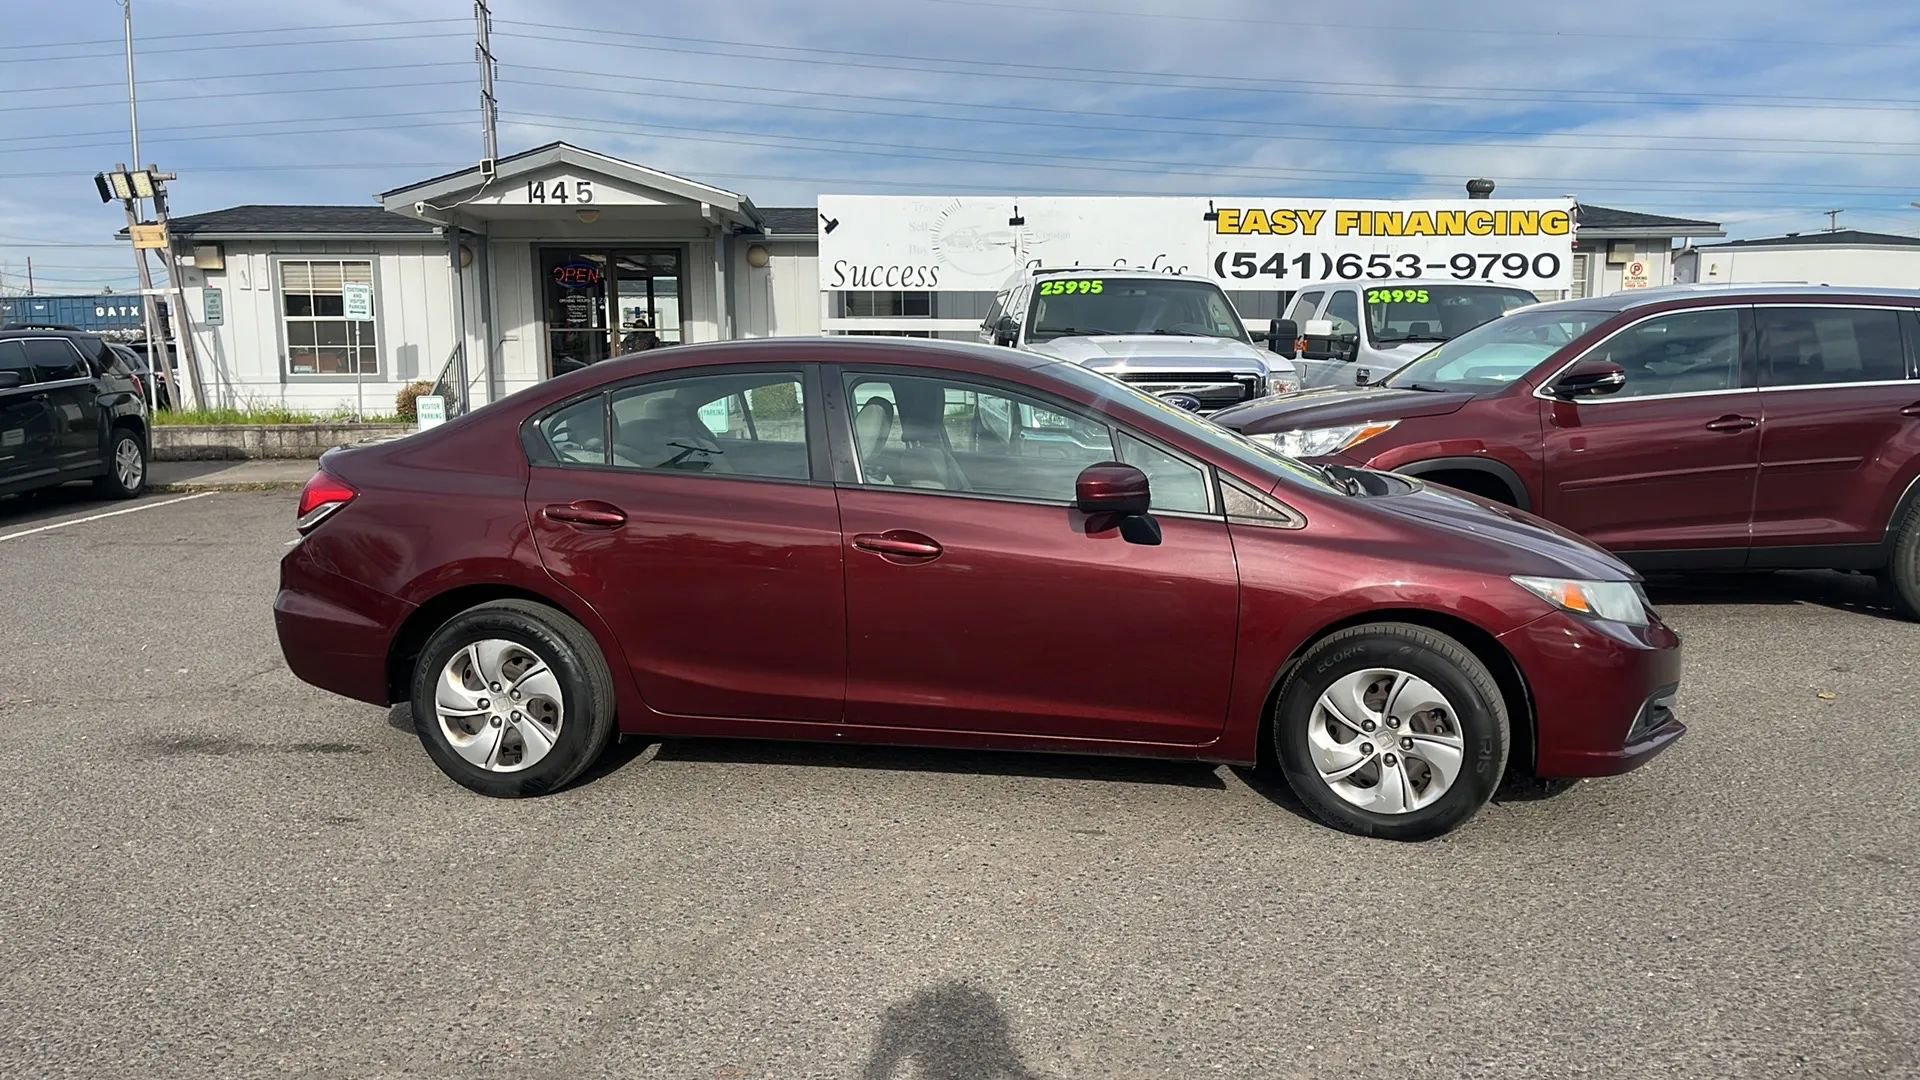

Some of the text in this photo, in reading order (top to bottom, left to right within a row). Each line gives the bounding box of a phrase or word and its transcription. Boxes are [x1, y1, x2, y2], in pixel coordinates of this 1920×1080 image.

[528, 181, 593, 203] 1445
[1216, 208, 1569, 236] EASY FINANCING
[553, 267, 600, 283] OPEN
[830, 259, 940, 288] Success
[1214, 251, 1561, 280] (541)653-9790
[1040, 280, 1104, 295] 25995
[1367, 289, 1430, 304] 24995
[421, 402, 441, 410] VISITOR
